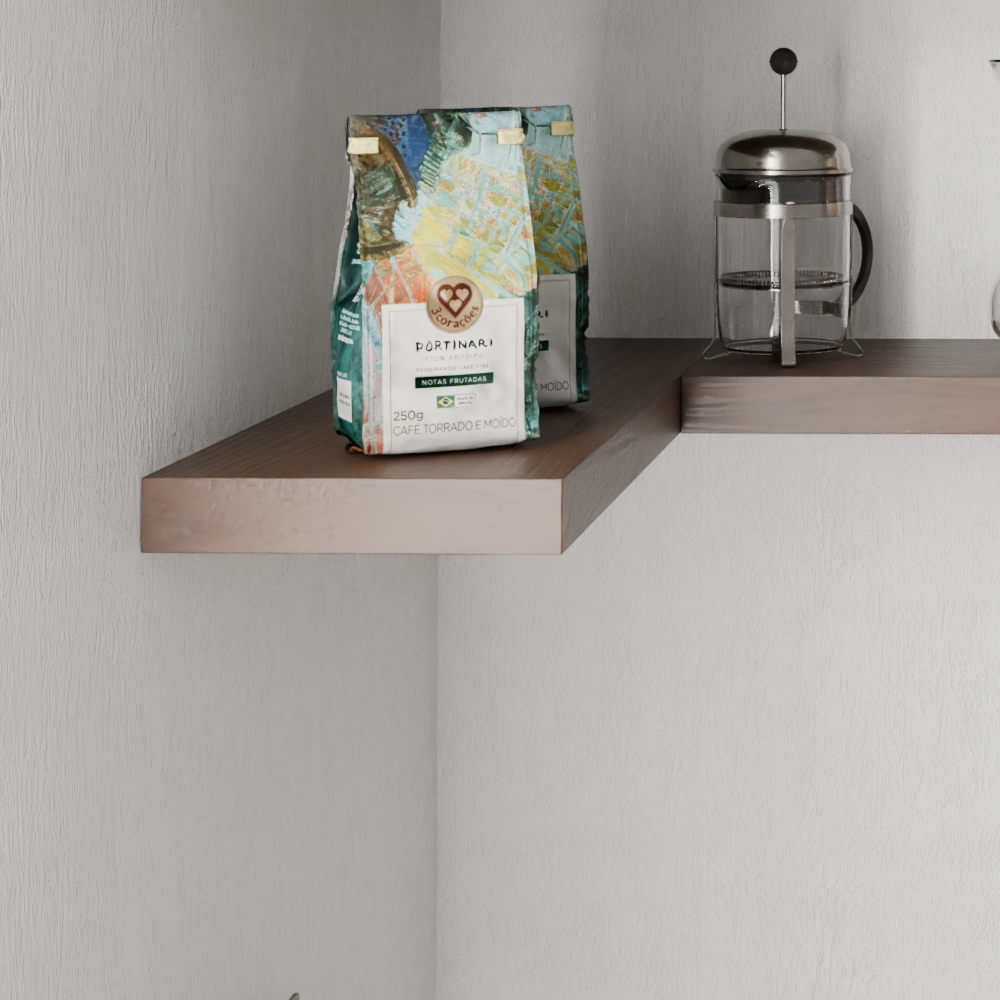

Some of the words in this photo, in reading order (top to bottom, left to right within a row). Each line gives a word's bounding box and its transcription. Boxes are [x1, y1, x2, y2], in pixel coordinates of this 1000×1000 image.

[415, 338, 493, 353] PORTINARI
[421, 378, 447, 386] NOTAS
[449, 375, 487, 384] FRUTADAS
[540, 380, 570, 392] MOÍDO
[393, 410, 424, 422] 250g
[392, 423, 420, 436] CAFÉ
[423, 421, 473, 434] TORRADO
[475, 420, 482, 430] E
[484, 416, 517, 430] MOÍDO
